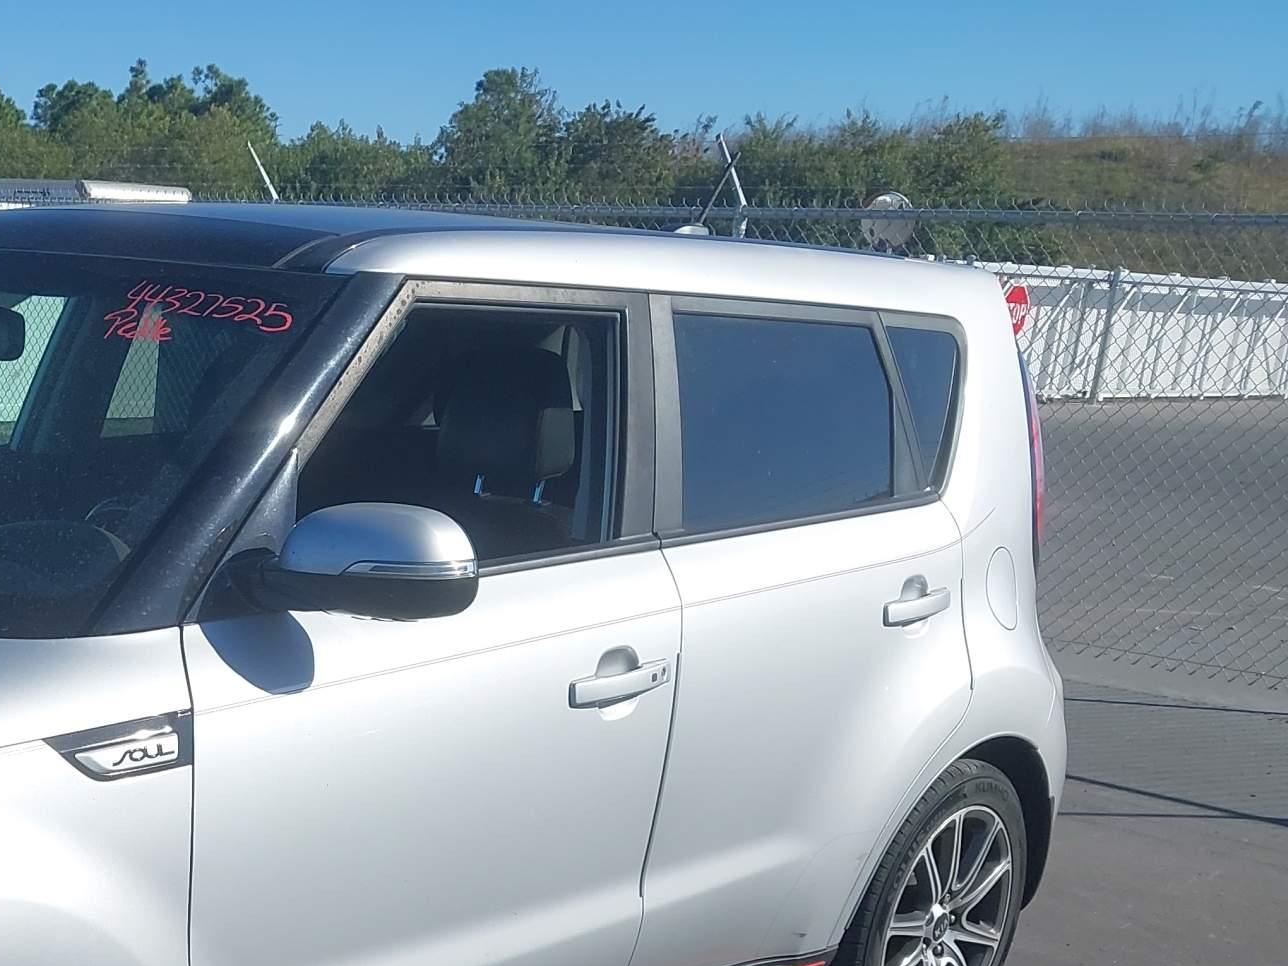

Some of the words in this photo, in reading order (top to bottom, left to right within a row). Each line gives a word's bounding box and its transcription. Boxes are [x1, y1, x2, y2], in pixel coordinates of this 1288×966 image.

[120, 280, 294, 333] 44327525
[112, 743, 175, 767] SOUL
[934, 918, 949, 938] KIA
